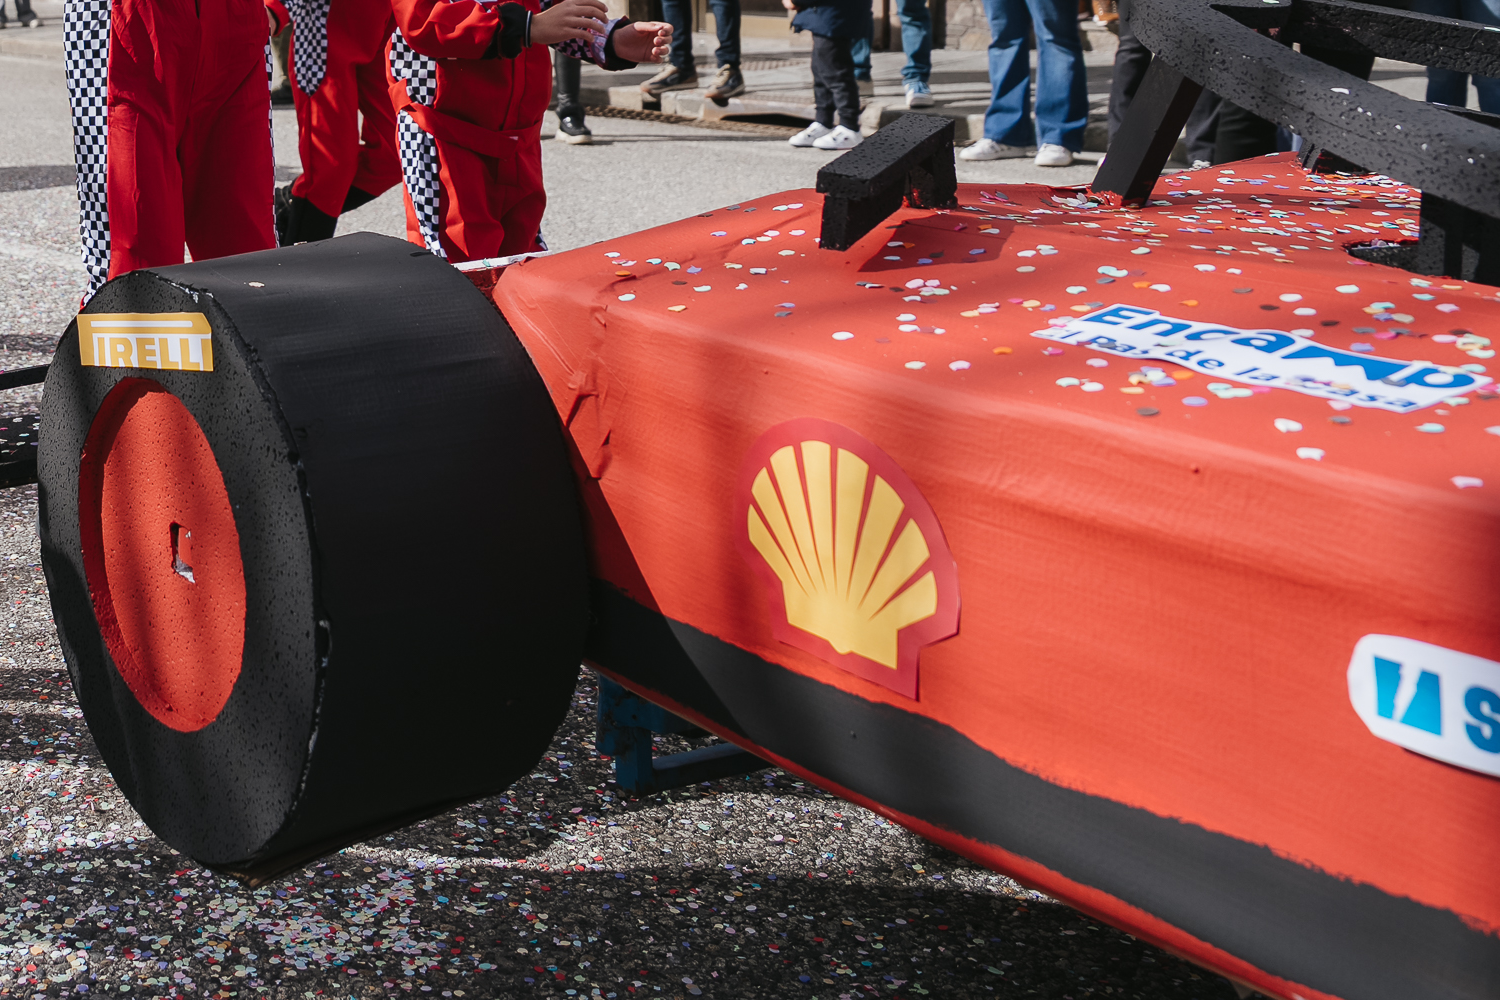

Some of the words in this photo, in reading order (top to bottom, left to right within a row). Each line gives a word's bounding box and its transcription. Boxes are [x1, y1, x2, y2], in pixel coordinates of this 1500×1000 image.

[1081, 306, 1476, 388] Encamp
[1164, 349, 1225, 370] de
[1232, 366, 1281, 382] la
